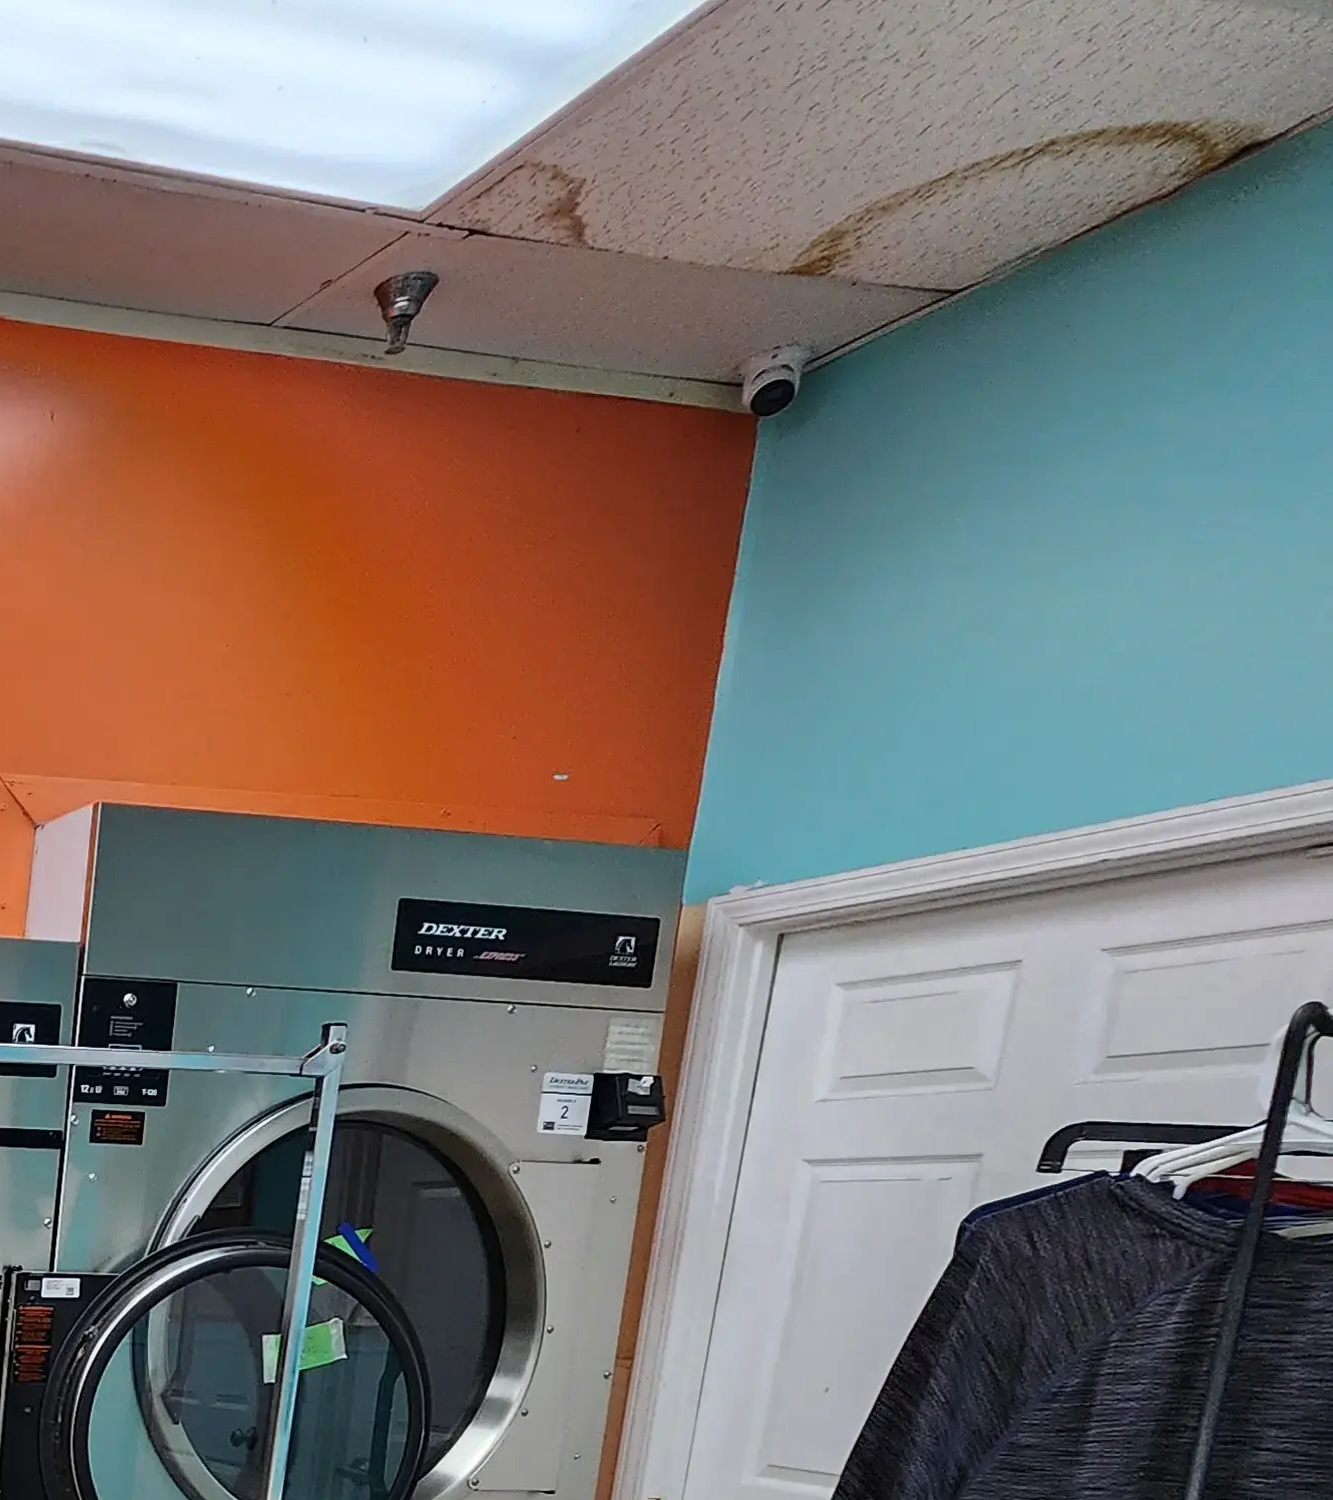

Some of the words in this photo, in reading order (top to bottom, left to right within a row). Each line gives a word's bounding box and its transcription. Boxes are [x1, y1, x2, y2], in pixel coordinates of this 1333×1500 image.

[418, 922, 507, 940] DEXTER
[415, 946, 464, 958] DRYER
[560, 1106, 569, 1119] 2
